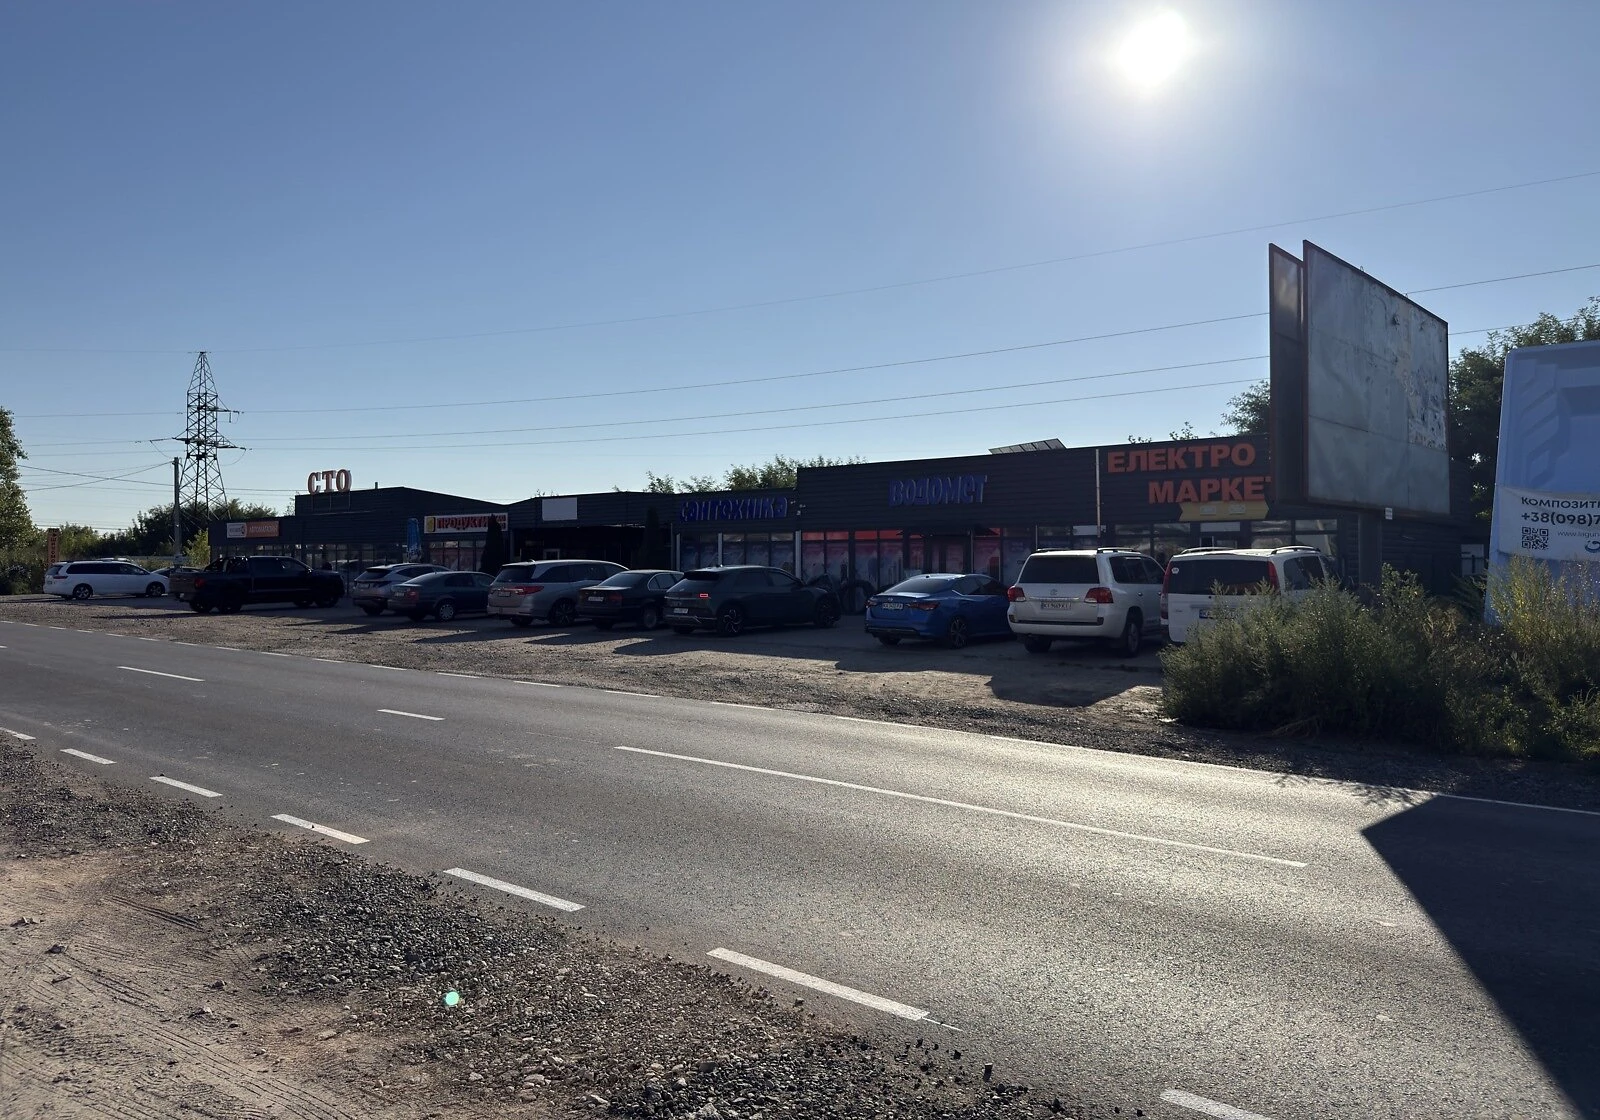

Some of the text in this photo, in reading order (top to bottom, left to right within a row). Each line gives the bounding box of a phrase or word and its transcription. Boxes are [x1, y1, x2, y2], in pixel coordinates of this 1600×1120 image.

[1107, 443, 1256, 473] ЕЛЕКТРО
[308, 469, 352, 495] СТО
[1148, 476, 1272, 505] МАРКЕ
